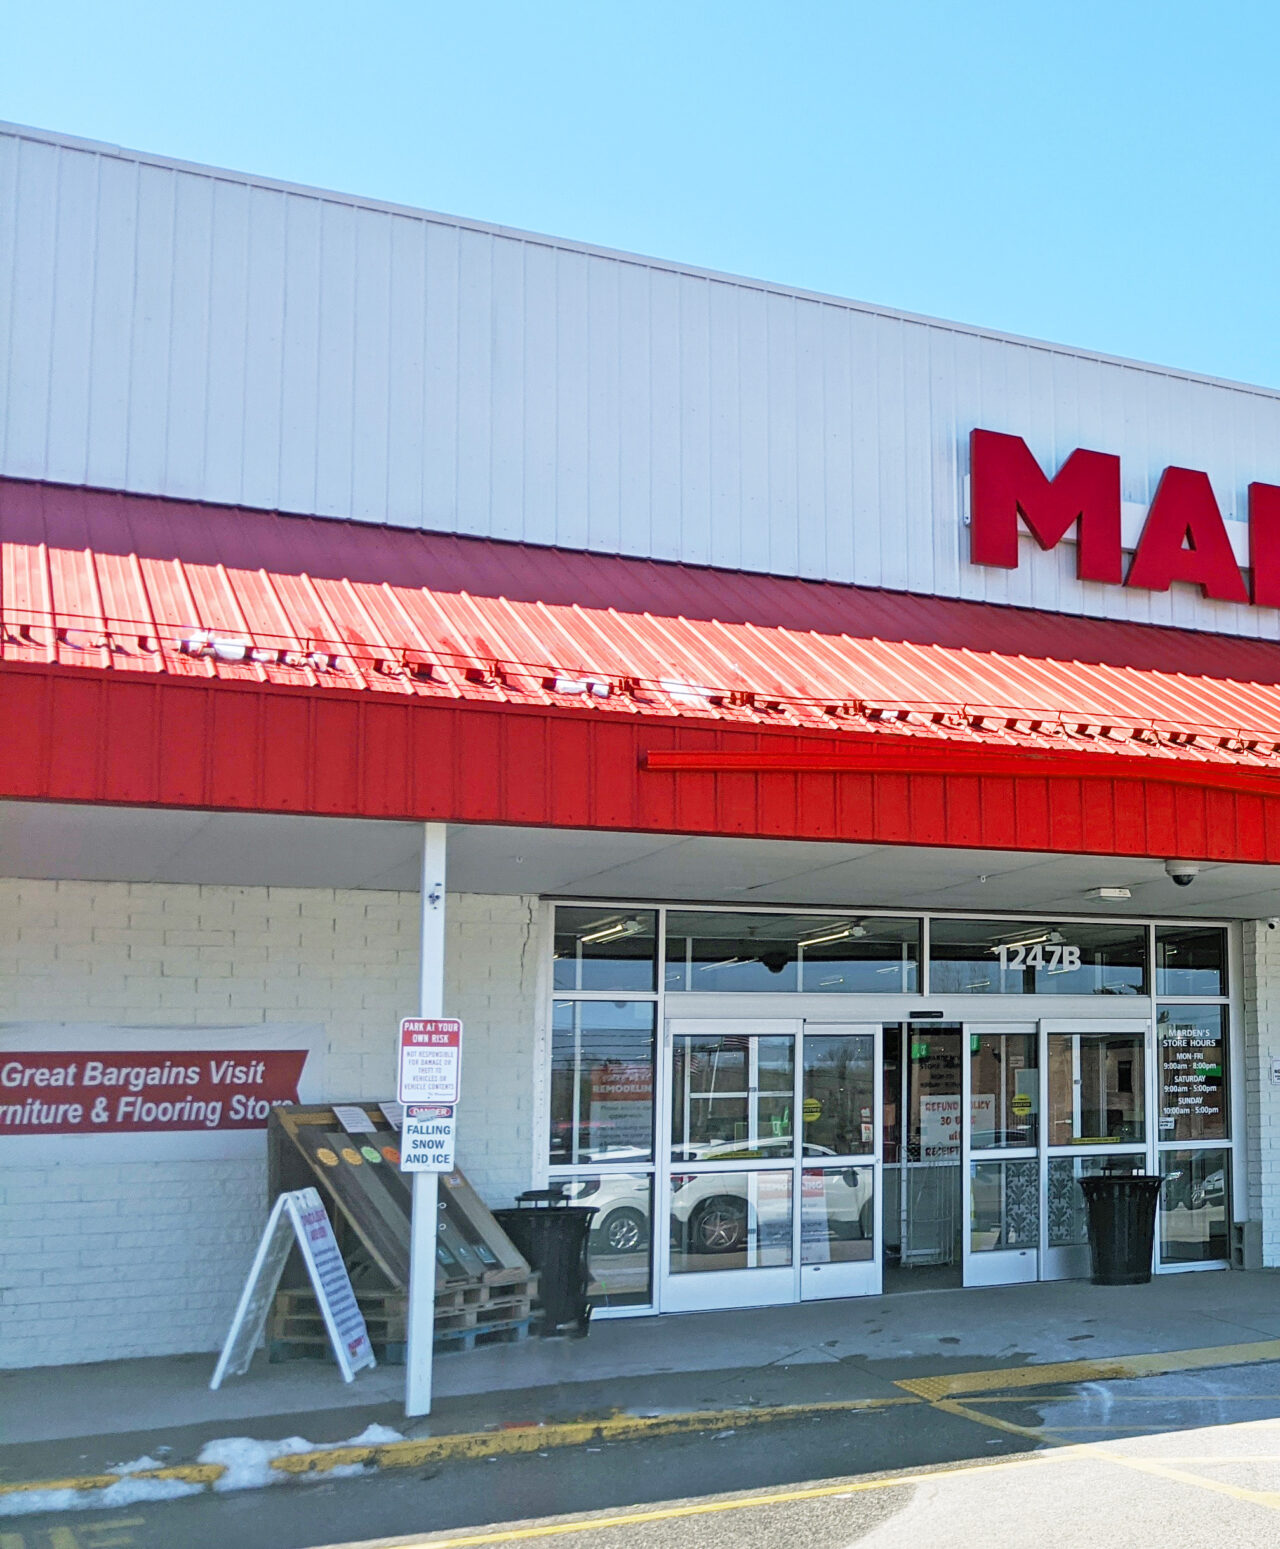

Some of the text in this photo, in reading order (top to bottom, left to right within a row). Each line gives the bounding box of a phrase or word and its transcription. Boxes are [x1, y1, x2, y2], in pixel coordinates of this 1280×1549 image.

[994, 944, 1081, 971] 1247B
[404, 1022, 458, 1032] PARK AT YOUR
[1168, 1029, 1210, 1037] MARDEN'S
[412, 1034, 449, 1043] OWN RISK
[1163, 1039, 1216, 1047] STORE HOURS
[1163, 1062, 1188, 1070] 9:00am
[1, 1060, 265, 1091] Great Bargains Visit
[1174, 1075, 1206, 1083] SATURDAY
[1164, 1085, 1188, 1093] 9:00am
[1178, 1097, 1204, 1105] SUNDAY
[90, 1096, 110, 1123] &
[116, 1096, 223, 1128] Flooring
[229, 1094, 294, 1121] Sto
[925, 1101, 960, 1112] REFUND
[1163, 1107, 1191, 1115] 10:00am
[940, 1116, 952, 1125] 30
[407, 1125, 451, 1135] FALLING
[411, 1139, 445, 1149] SNOW
[925, 1147, 960, 1157] RECEIPT
[405, 1153, 451, 1164] AND ICE
